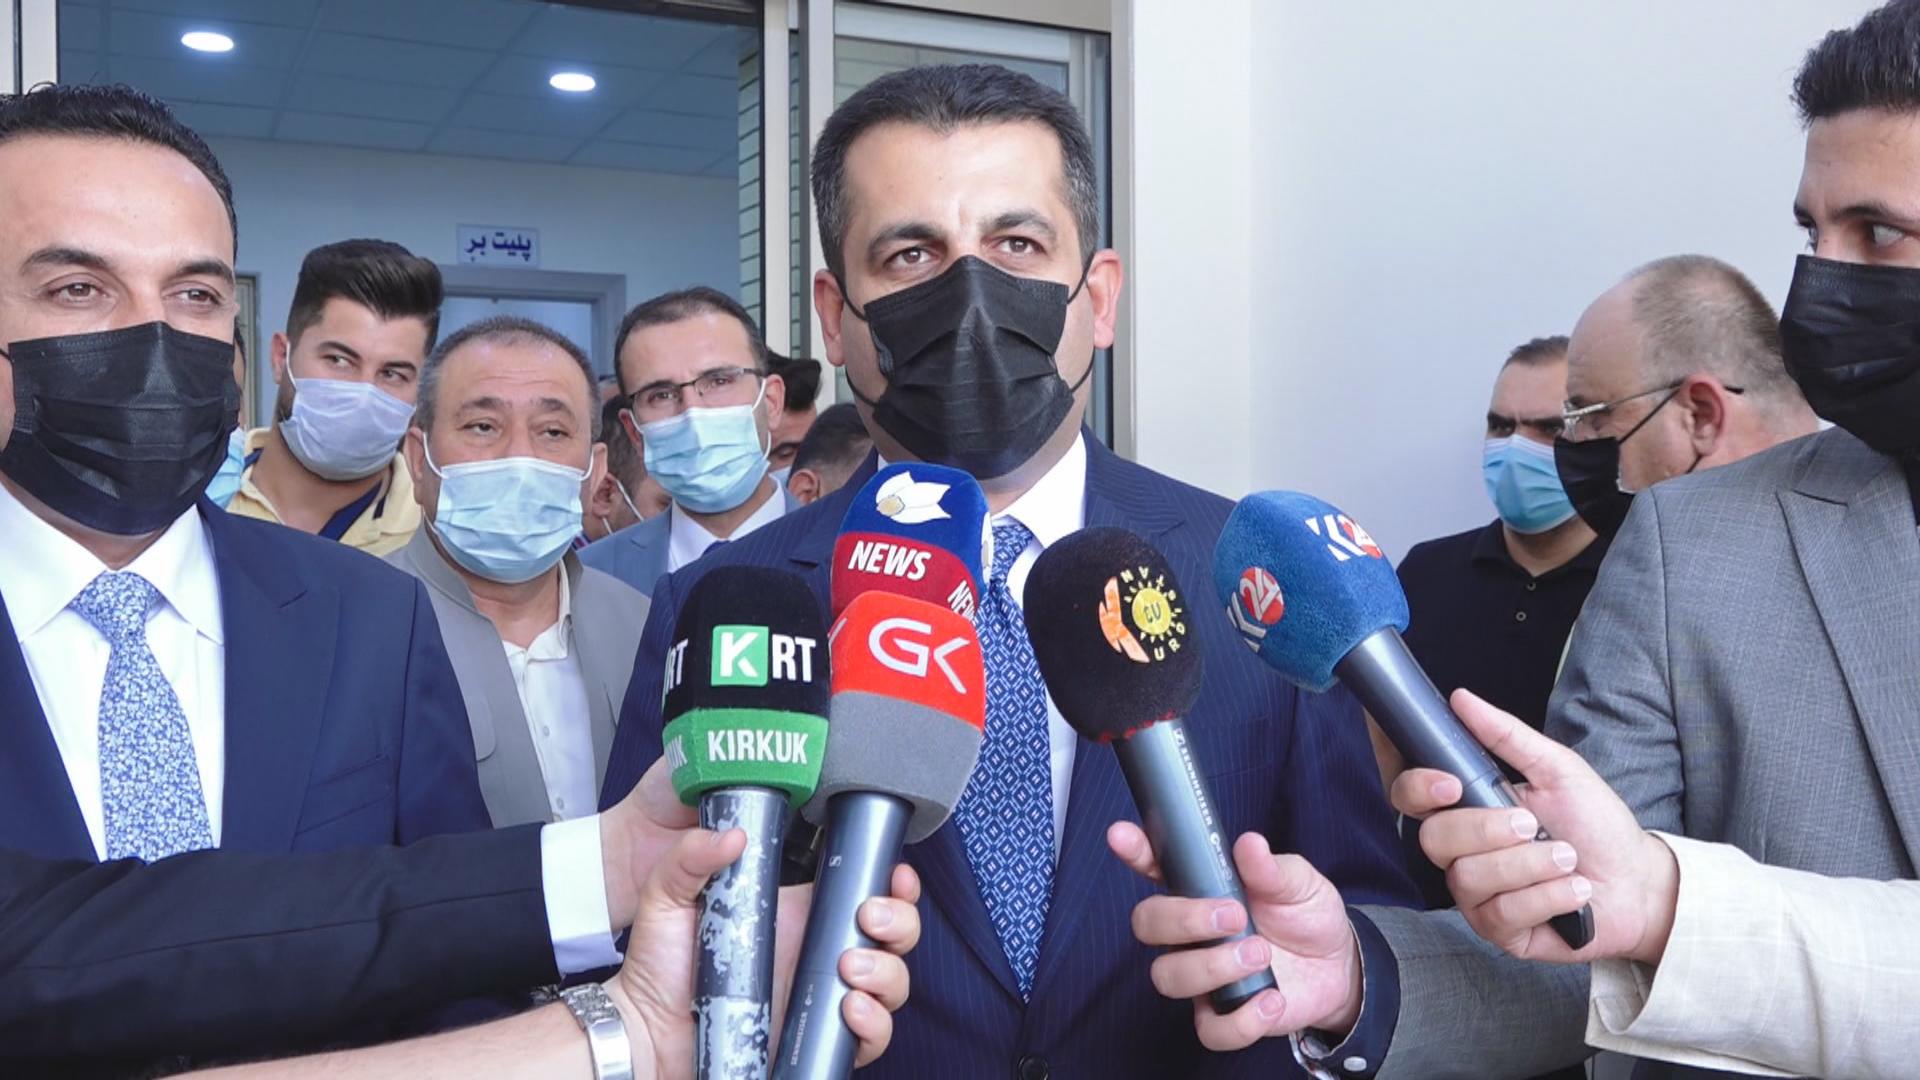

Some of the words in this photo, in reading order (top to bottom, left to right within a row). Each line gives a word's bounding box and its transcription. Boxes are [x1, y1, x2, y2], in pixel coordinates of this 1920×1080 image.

[847, 540, 932, 581] NEWS
[719, 631, 816, 683] KRT
[868, 617, 971, 694] GK
[707, 729, 809, 765] KIRKUK
